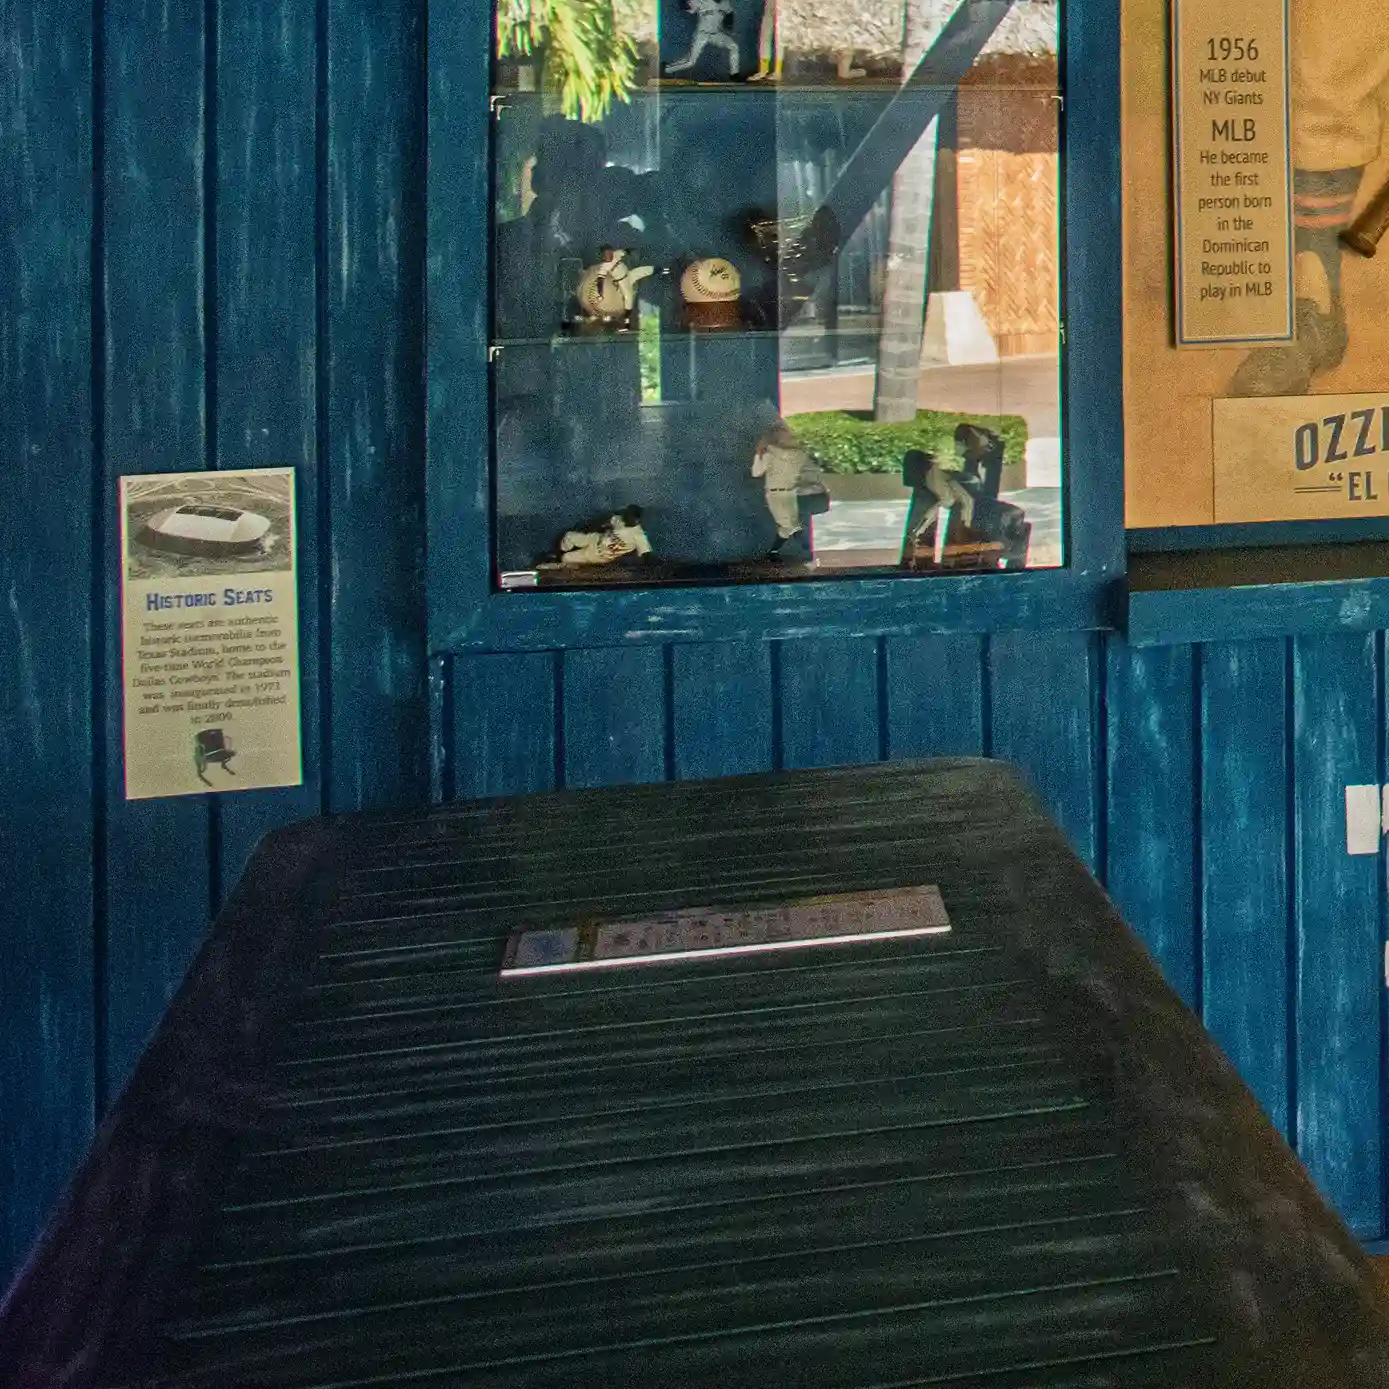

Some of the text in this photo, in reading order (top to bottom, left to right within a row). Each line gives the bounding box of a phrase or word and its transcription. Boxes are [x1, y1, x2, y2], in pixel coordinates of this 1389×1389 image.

[1207, 37, 1259, 61] 1956
[1200, 68, 1267, 83] MLB debut
[1203, 90, 1263, 105] NY Giants
[1211, 118, 1256, 142] MLB
[1200, 150, 1269, 165] He became
[1210, 172, 1259, 187] the first
[1198, 194, 1272, 213] person born
[1217, 216, 1254, 231] in the
[1202, 238, 1270, 253] Dominican
[1201, 260, 1272, 277] Republic to
[1200, 281, 1273, 302] play in MLB
[146, 588, 273, 611] HISTORIC SEATS
